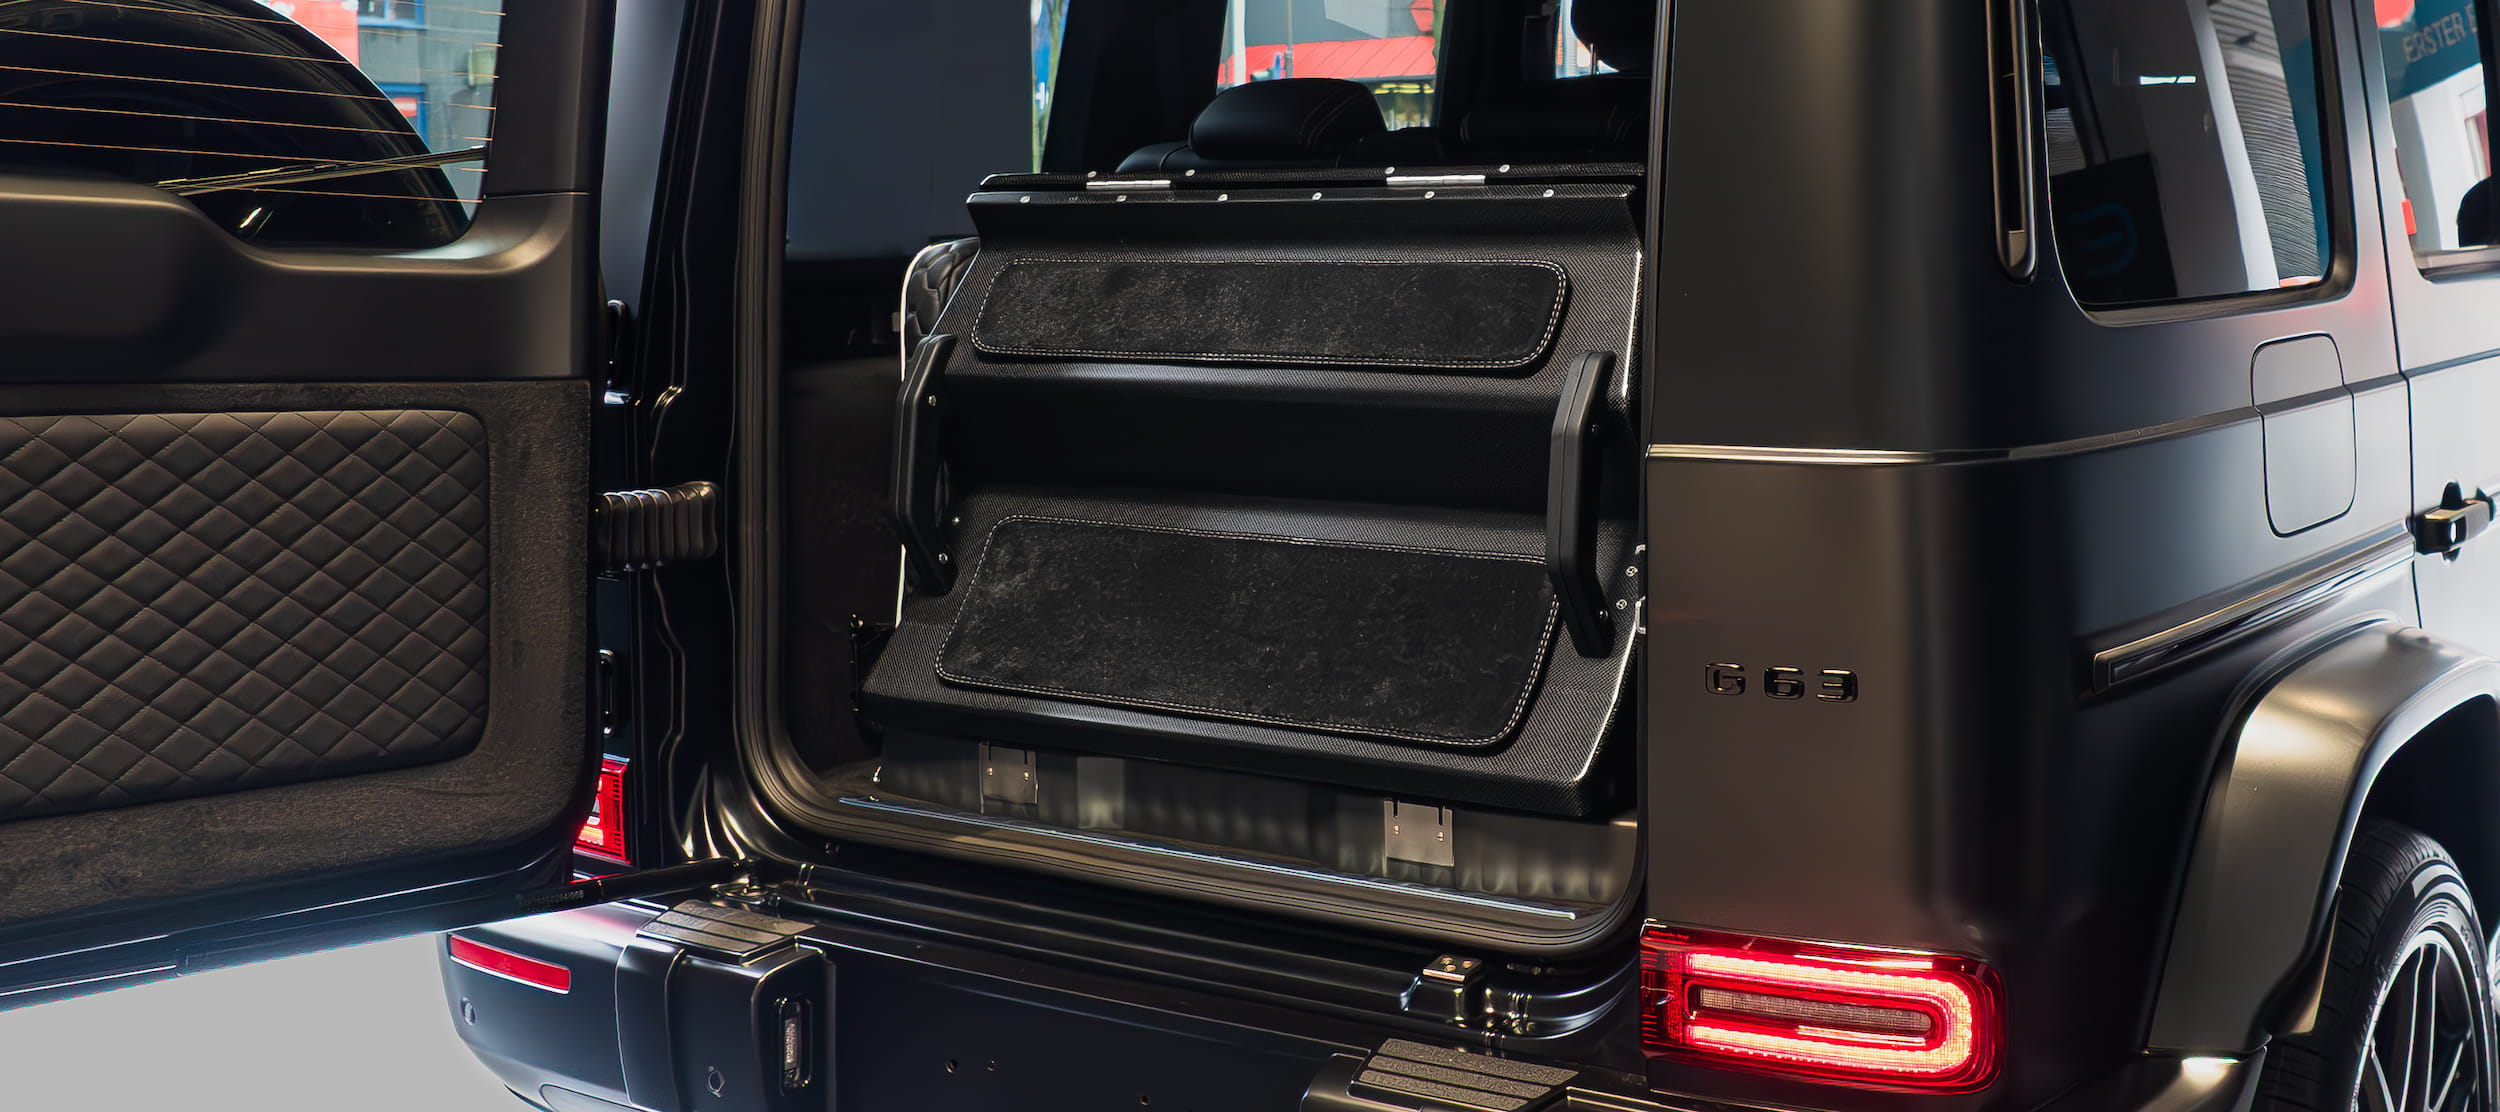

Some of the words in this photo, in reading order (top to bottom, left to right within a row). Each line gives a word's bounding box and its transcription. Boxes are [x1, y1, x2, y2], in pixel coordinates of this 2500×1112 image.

[2403, 12, 2466, 62] ERSTER
[1705, 663, 1746, 696] G
[1764, 666, 1858, 703] 63
